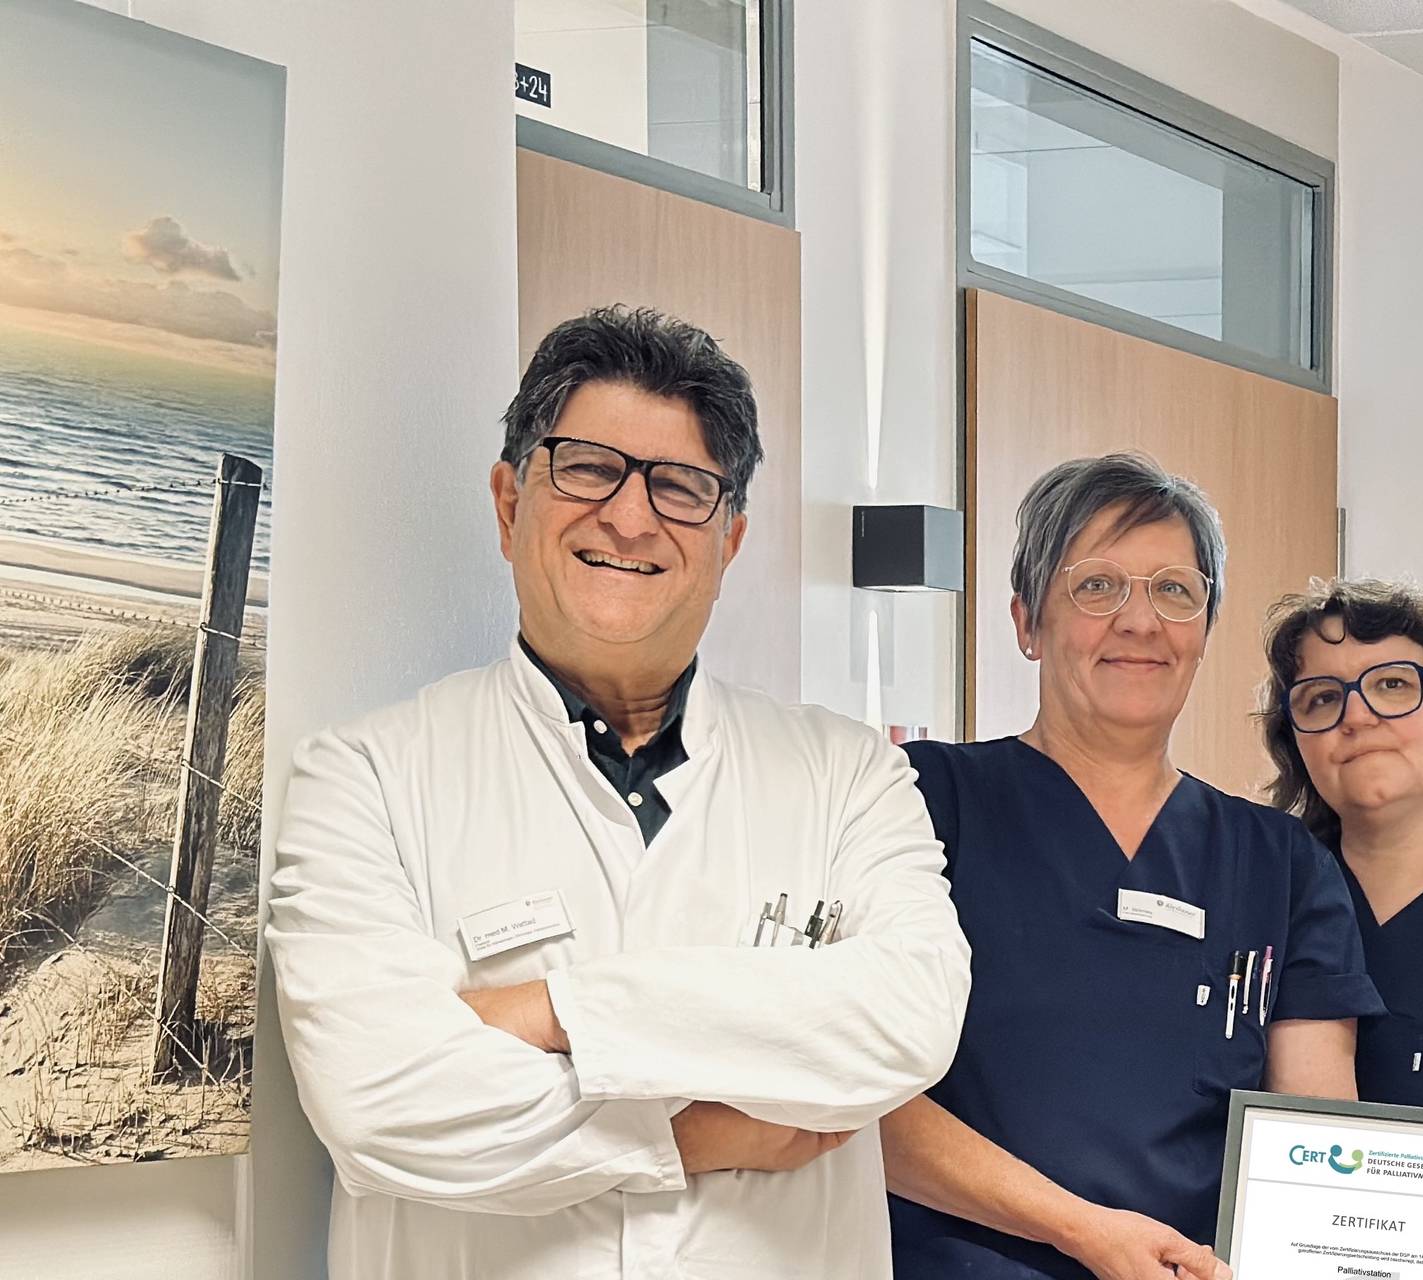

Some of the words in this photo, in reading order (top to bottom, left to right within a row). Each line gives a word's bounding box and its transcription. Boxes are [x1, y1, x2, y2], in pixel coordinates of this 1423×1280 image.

[1289, 1144, 1327, 1166] CERT
[1368, 1150, 1400, 1159] Zertifizierte
[1367, 1158, 1405, 1168] DEUTSCHE
[1366, 1167, 1381, 1175] FÜR
[1332, 1214, 1407, 1232] ZERTIFIKAT
[1337, 1265, 1392, 1279] Palliativstation
